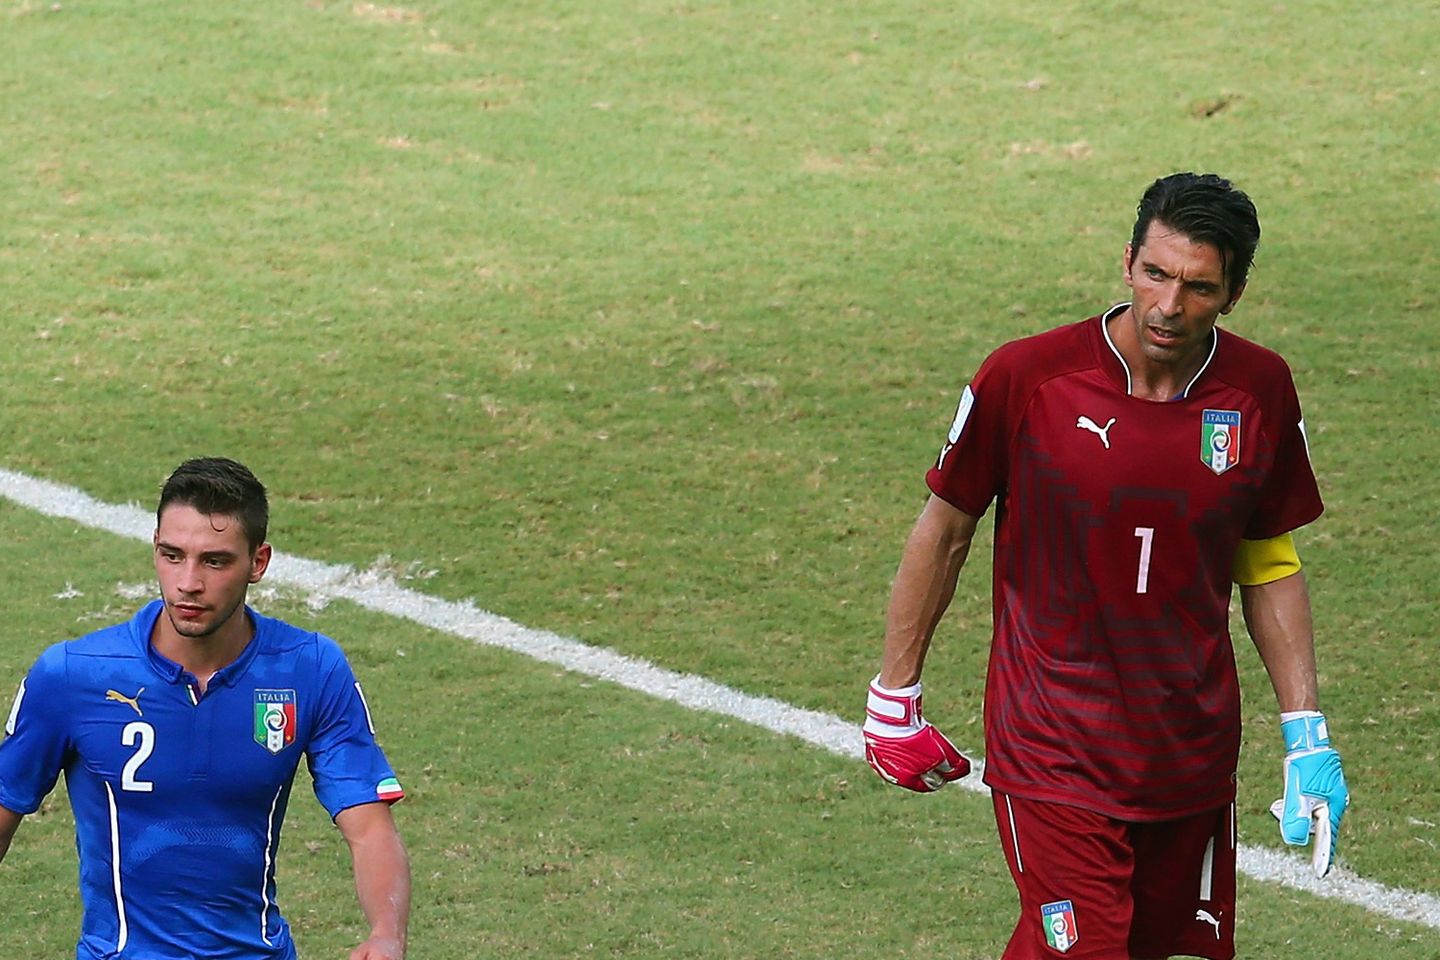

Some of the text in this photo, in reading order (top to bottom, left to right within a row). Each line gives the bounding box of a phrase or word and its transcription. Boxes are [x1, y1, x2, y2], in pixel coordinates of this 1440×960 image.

[1206, 413, 1237, 423] ITALIA
[1134, 527, 1154, 593] 1
[258, 693, 291, 702] ITALIA
[122, 721, 155, 792] 2
